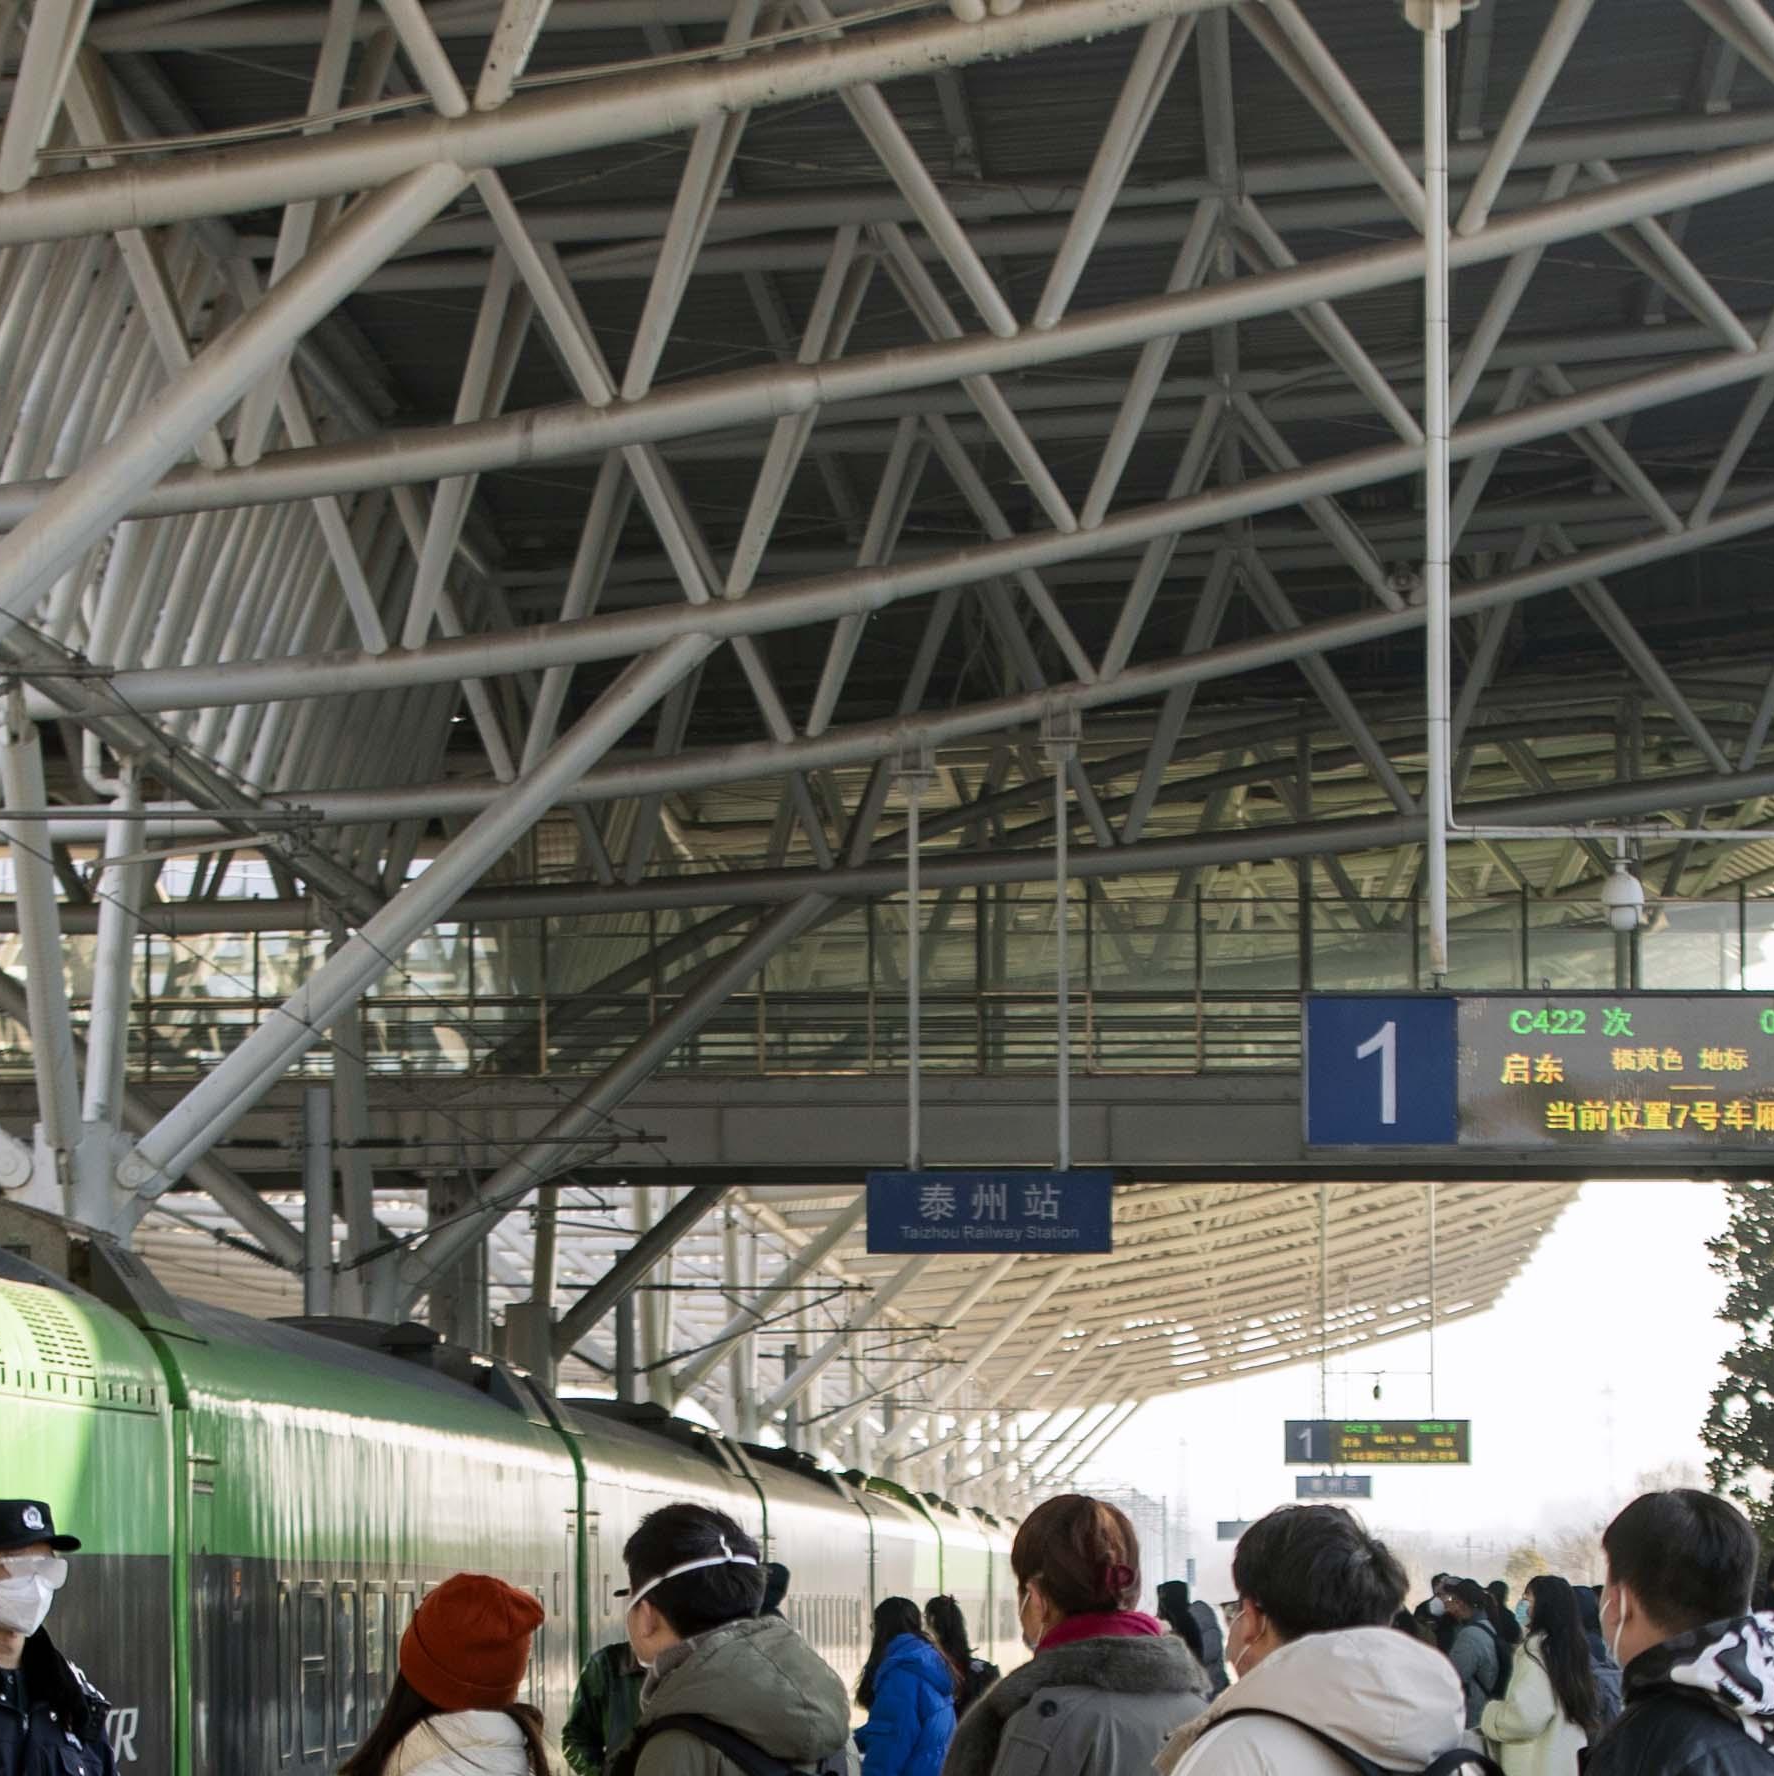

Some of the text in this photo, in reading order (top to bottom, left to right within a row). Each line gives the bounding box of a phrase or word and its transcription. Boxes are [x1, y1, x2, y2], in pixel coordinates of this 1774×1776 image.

[1509, 1006, 1635, 1037] C422 次
[1355, 1021, 1396, 1125] 1
[1500, 1053, 1565, 1085] 启东
[1697, 1047, 1749, 1072] 地标
[917, 1183, 1062, 1222] 泰州站
[899, 1225, 1080, 1242] Taizhou Railway Station
[1297, 1427, 1313, 1460] 1
